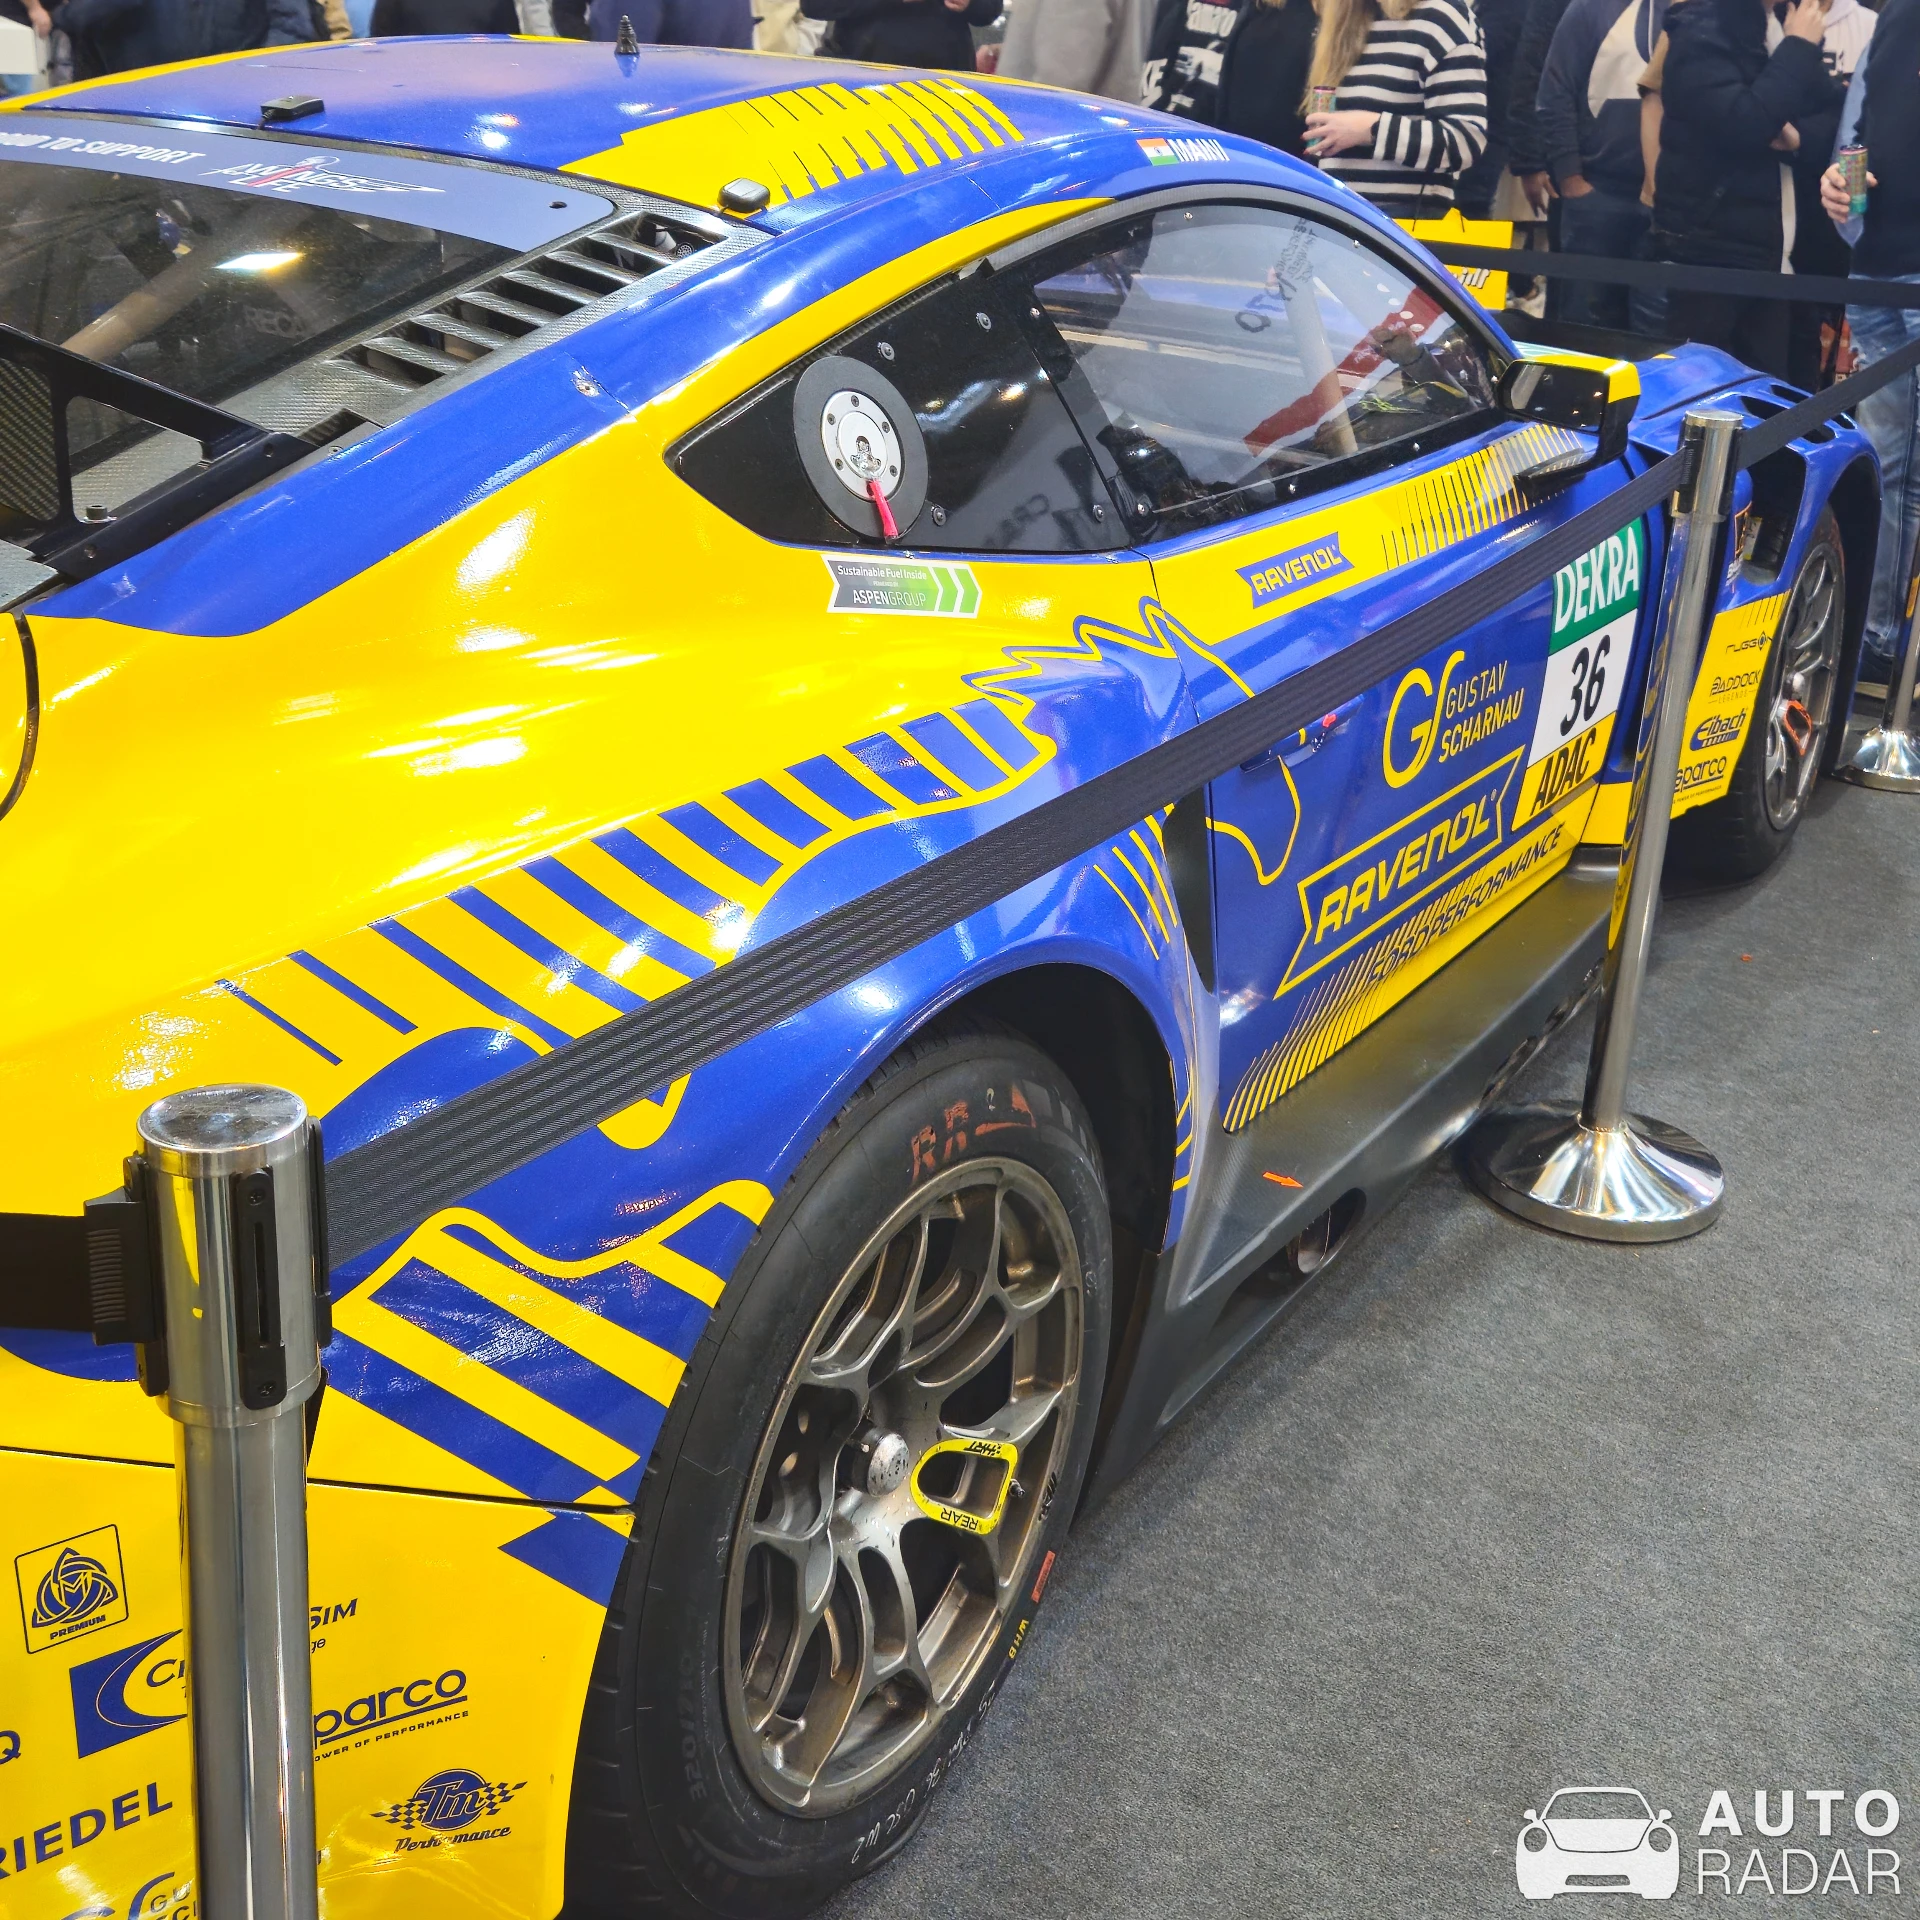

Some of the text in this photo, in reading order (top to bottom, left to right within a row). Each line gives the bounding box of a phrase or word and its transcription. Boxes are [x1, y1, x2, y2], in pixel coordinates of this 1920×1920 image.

[38, 136, 87, 151] TO
[71, 140, 207, 164] SUPPORT
[837, 564, 927, 580] Sustainable Fuel Inside
[1250, 545, 1343, 596] RAVENOL
[1553, 526, 1640, 634] DEKRA
[853, 589, 926, 607] ASPENGROUP
[1445, 660, 1508, 719] GUSTAV
[1559, 634, 1610, 737] 36
[1438, 687, 1525, 763] SCHARNAU
[1690, 708, 1747, 738] Eibach
[1529, 727, 1597, 817] ADAC
[1314, 795, 1491, 945] RAVENOL
[940, 1508, 979, 1531] REAR
[50, 1614, 107, 1640] PREMIUM
[313, 1668, 468, 1750] parco
[314, 1710, 469, 1762] OWER OF PERFORMANCE
